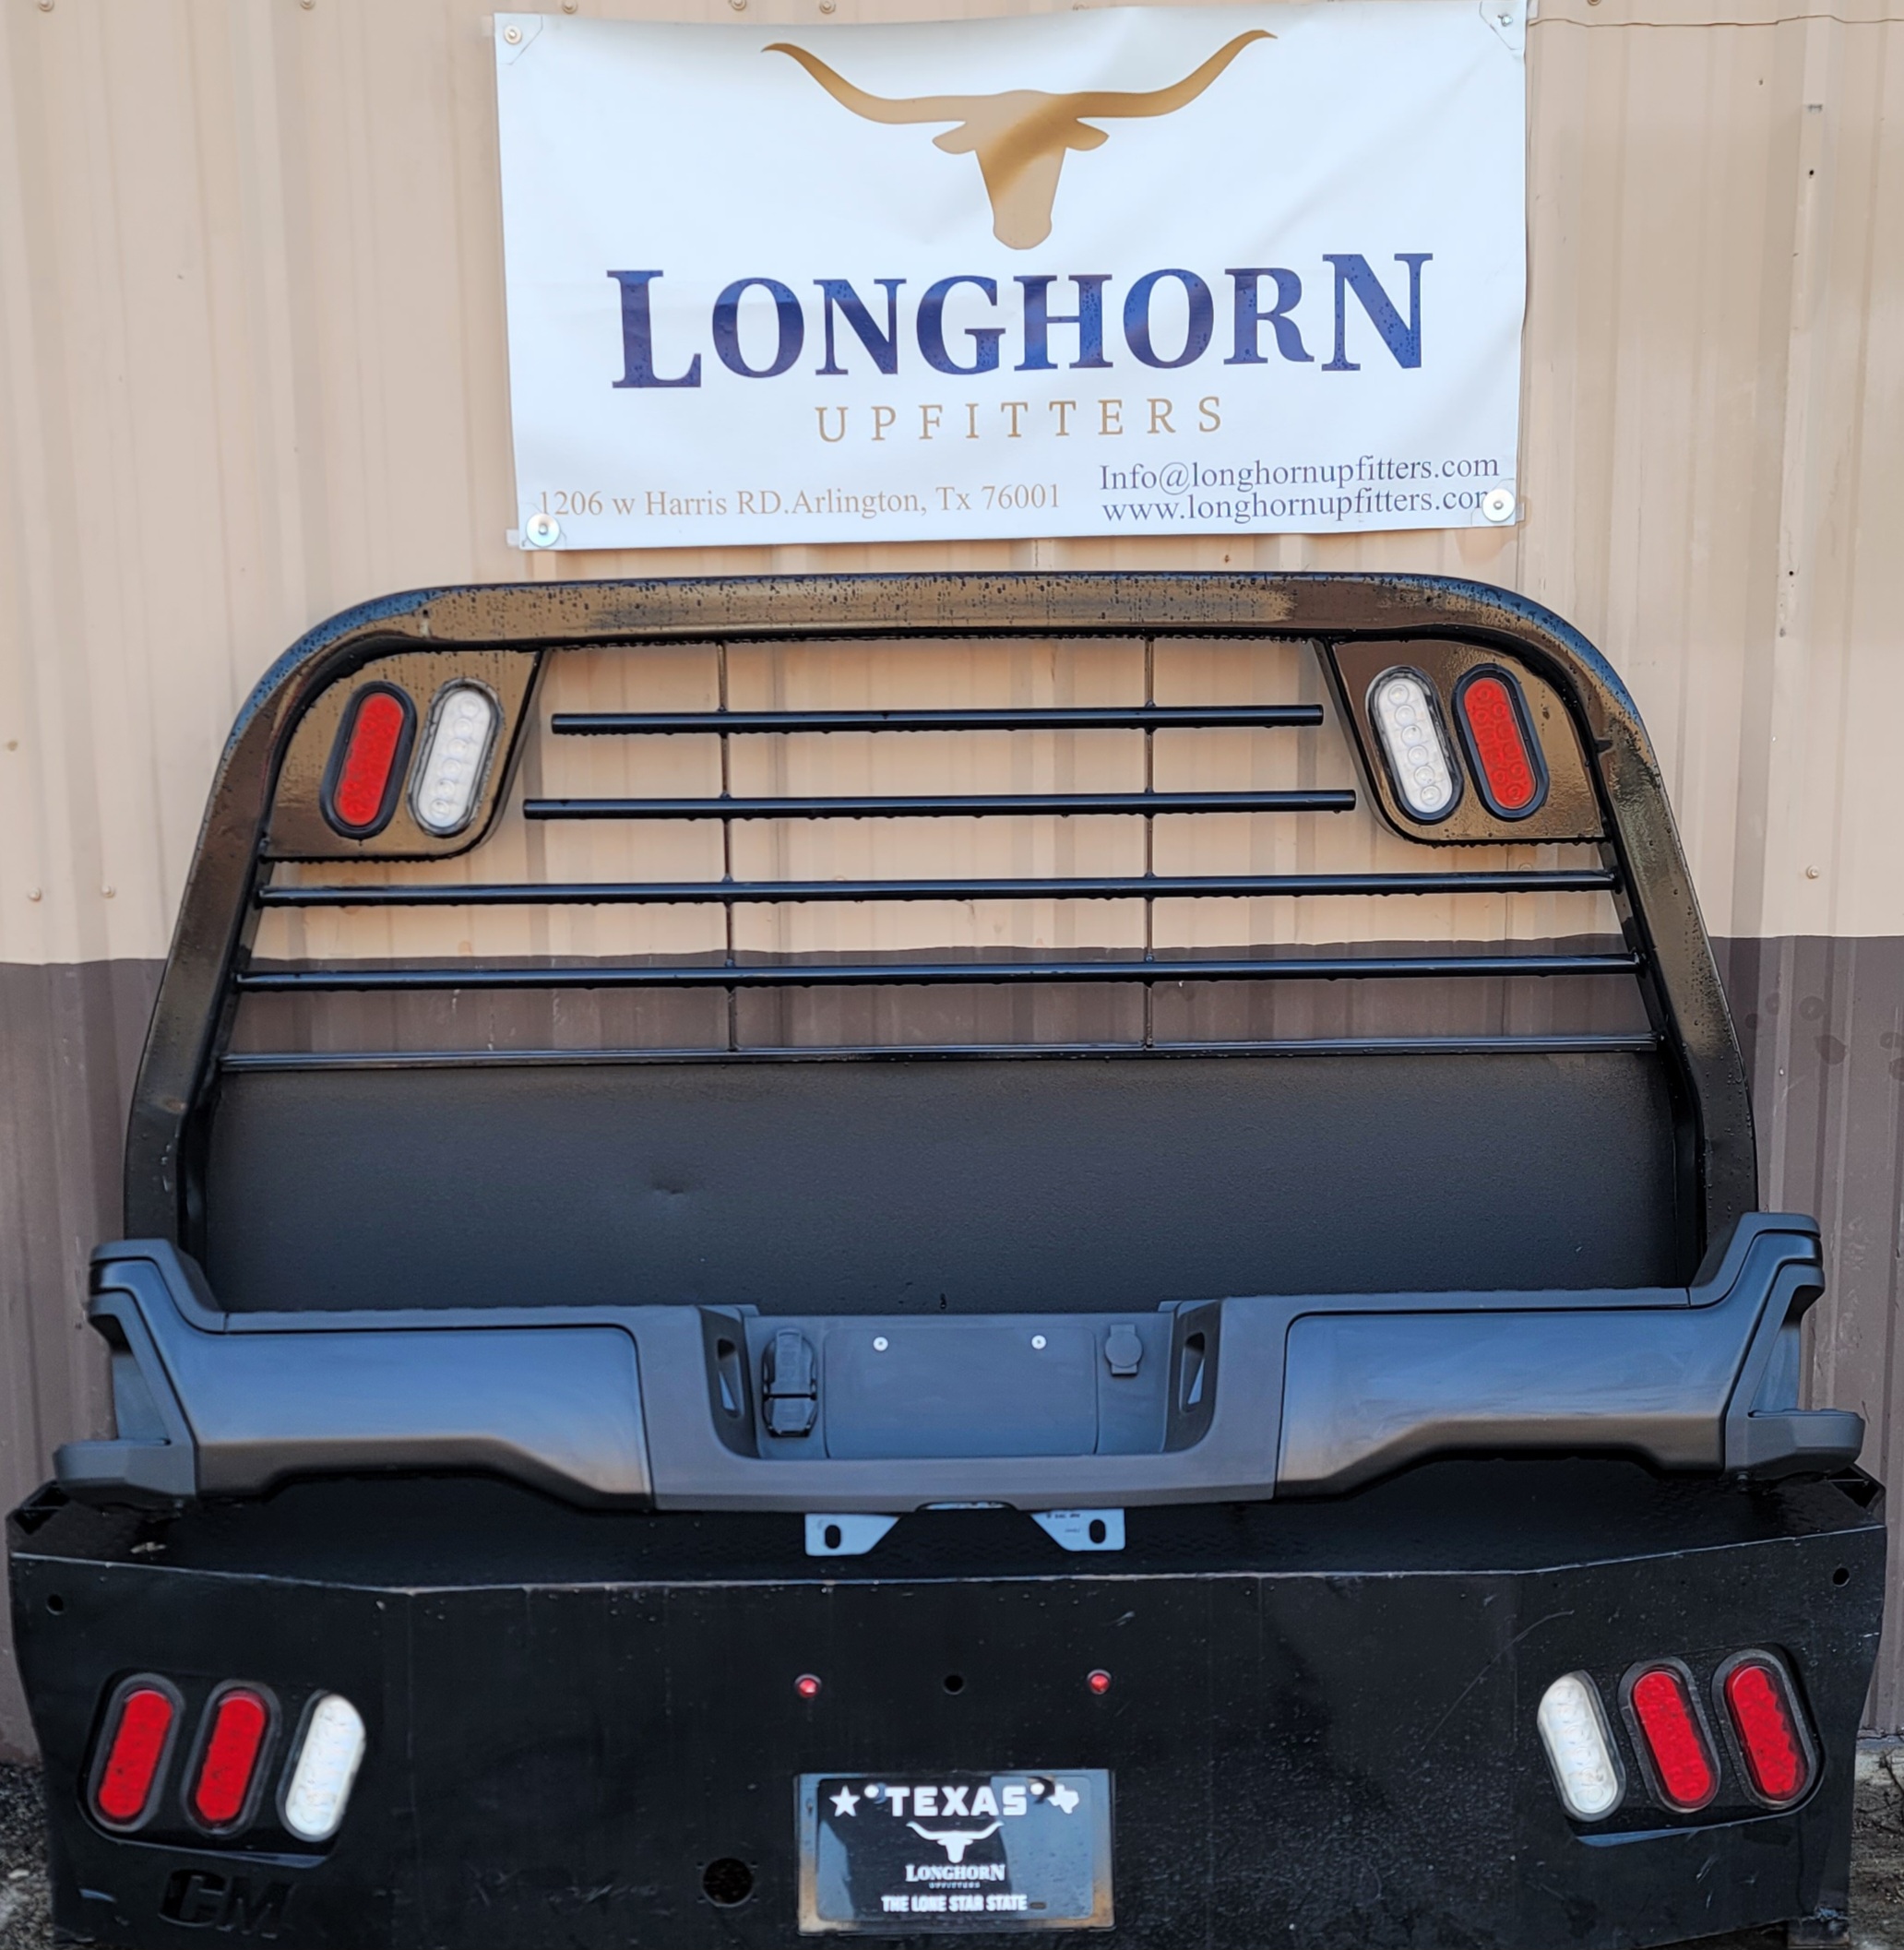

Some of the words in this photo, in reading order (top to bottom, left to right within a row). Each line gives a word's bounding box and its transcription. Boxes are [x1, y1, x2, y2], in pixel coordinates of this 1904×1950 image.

[606, 252, 1434, 388] LONGHORN
[815, 395, 1226, 444] UPFITTERS
[1100, 455, 1500, 495] Info@longhornupfitters.com
[540, 491, 602, 516] 1206
[612, 497, 635, 515] w
[645, 489, 727, 516] Harris
[736, 488, 927, 518] RD.Arlington,
[935, 486, 971, 510] Tx
[981, 483, 1060, 509] 76001
[885, 1786, 1027, 1817] TEXAS
[905, 1863, 1006, 1882] LONGHORN
[881, 1896, 910, 1912] THE
[910, 1896, 947, 1912] LONE
[948, 1895, 984, 1911] STAR
[986, 1894, 1028, 1911] STATE
